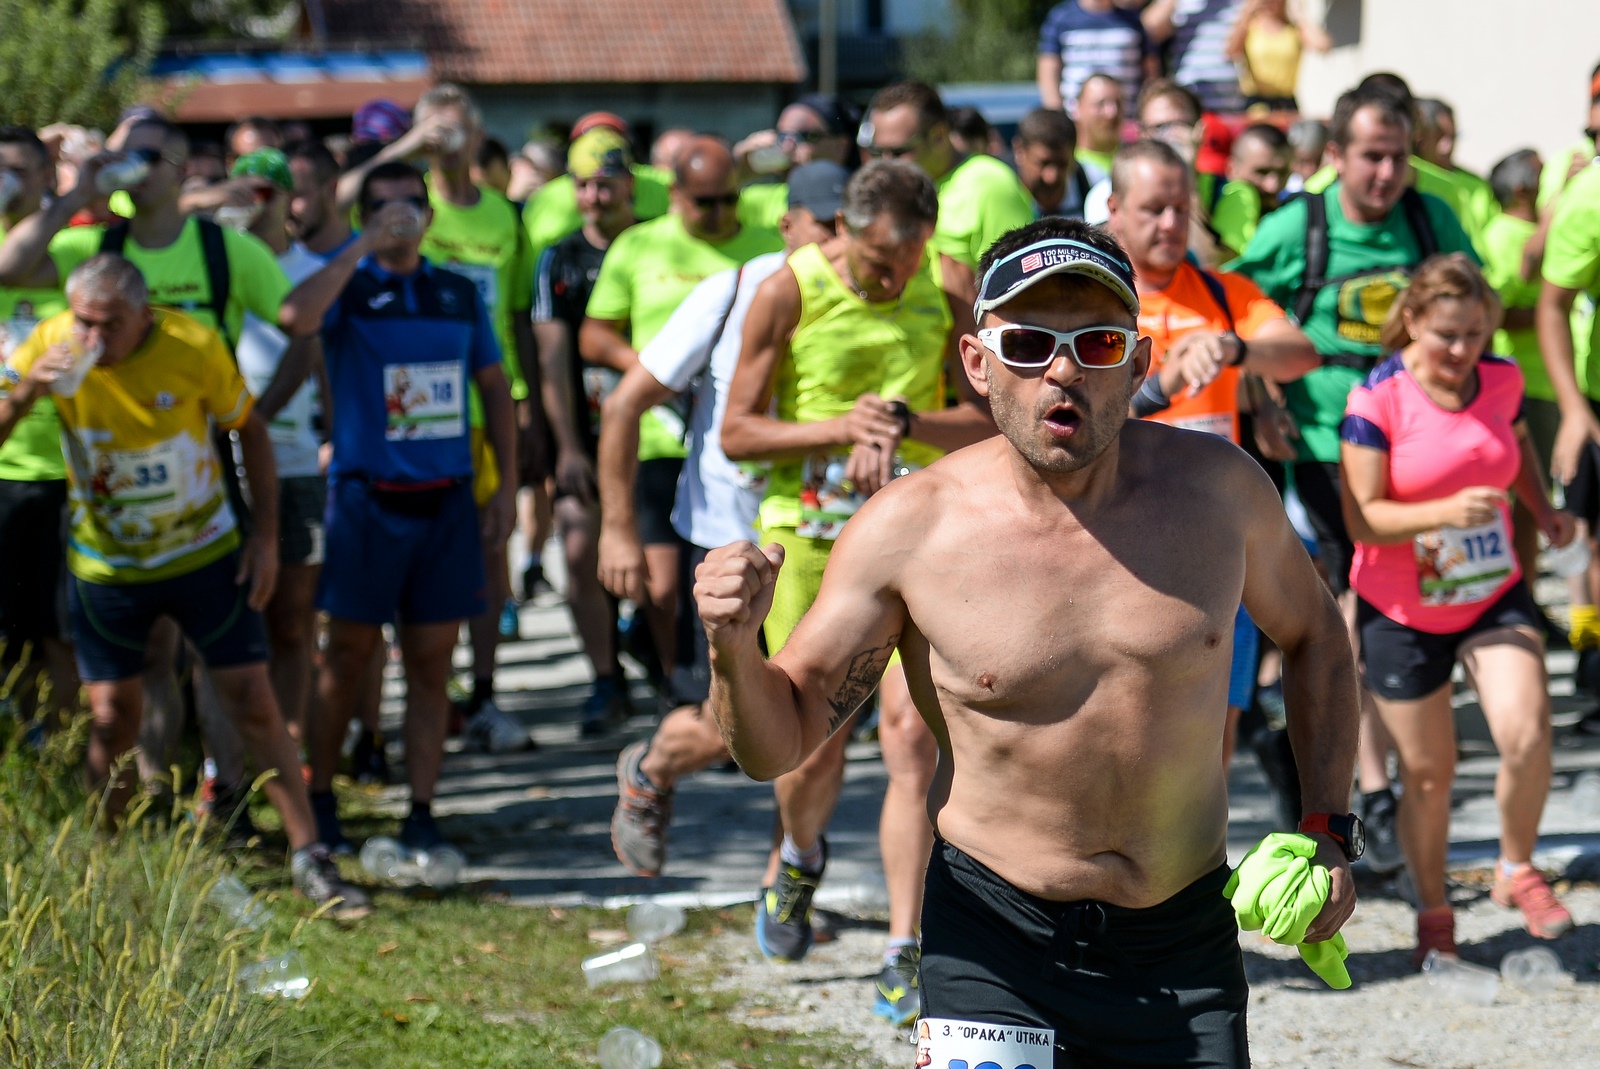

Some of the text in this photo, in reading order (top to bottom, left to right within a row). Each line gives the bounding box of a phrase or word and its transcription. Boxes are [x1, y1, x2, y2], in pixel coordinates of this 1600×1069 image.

[1043, 249, 1057, 257] 100
[1057, 248, 1079, 257] MILES
[136, 464, 167, 487] 33
[1464, 532, 1502, 561] 112
[942, 1025, 953, 1038] 3.
[1015, 1031, 1049, 1046] UTRKA
